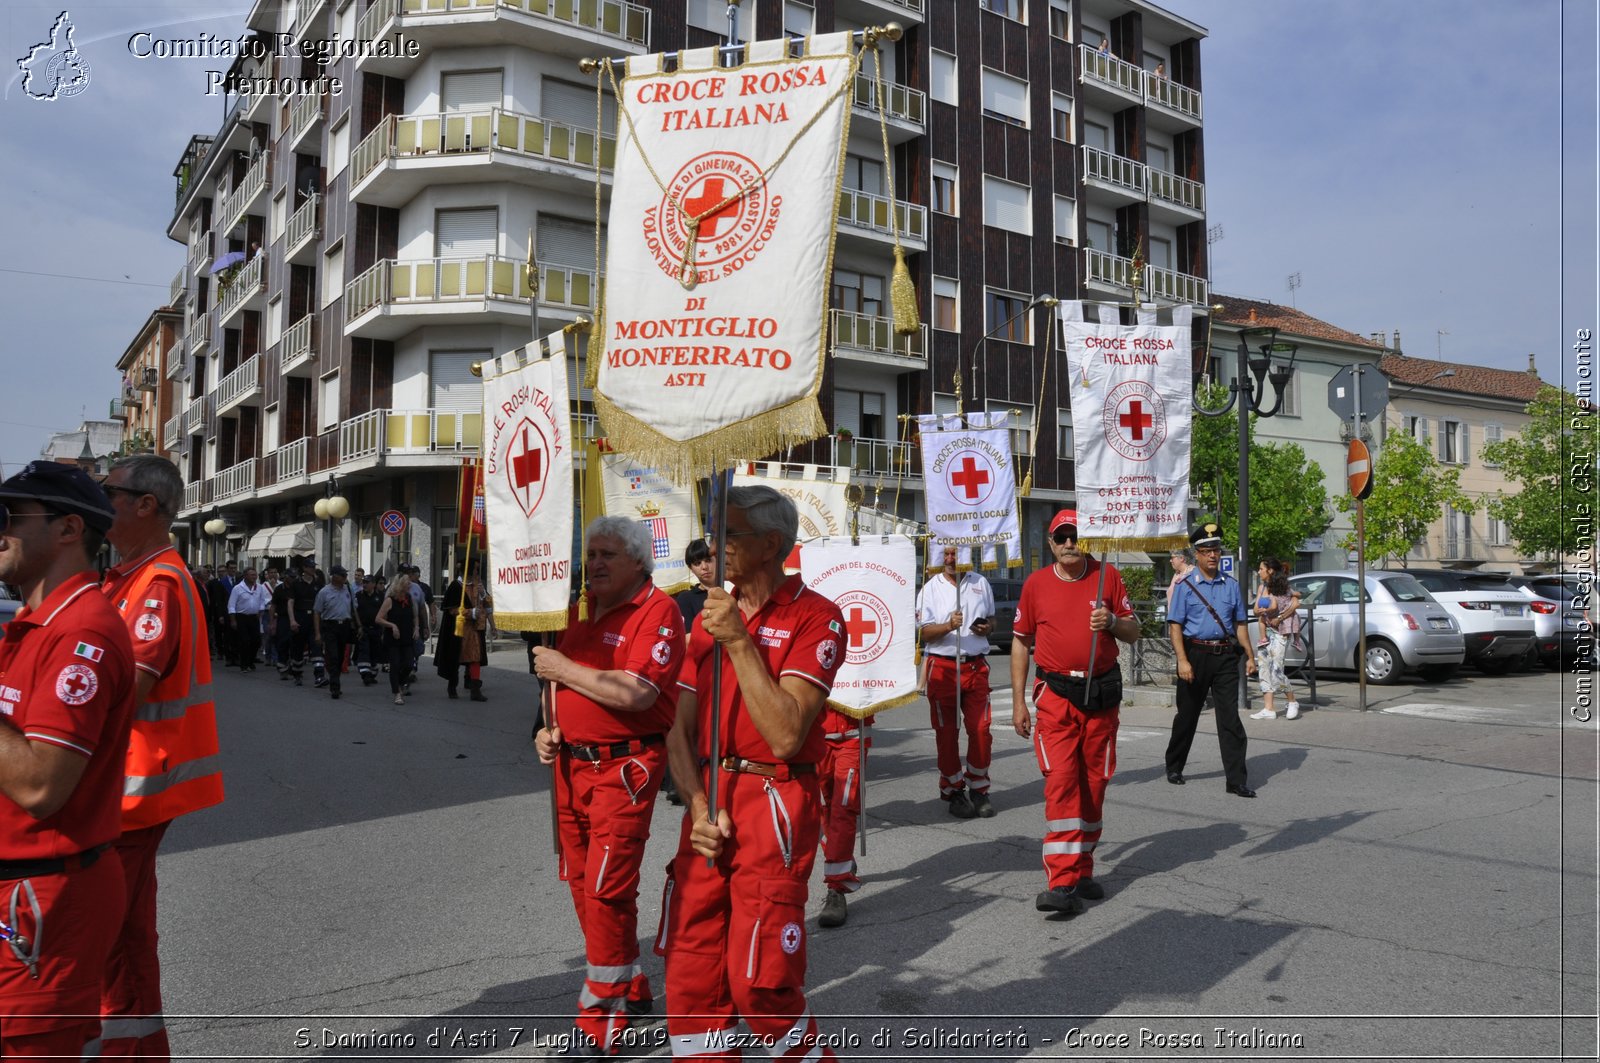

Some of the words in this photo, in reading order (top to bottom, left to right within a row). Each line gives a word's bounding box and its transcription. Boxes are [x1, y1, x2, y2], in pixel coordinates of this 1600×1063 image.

[636, 76, 726, 104] CROCE
[738, 64, 828, 97] ROSSA
[660, 101, 790, 132] ITALIANA
[694, 158, 742, 175] GINEVRA
[681, 171, 694, 183] DI
[714, 232, 744, 255] 1864
[722, 194, 784, 278] SOCCORSO
[684, 297, 706, 311] DI
[614, 316, 779, 341] MONTIGLIO
[1085, 335, 1127, 351] CROCE
[1133, 337, 1175, 350] ROSSA
[607, 346, 793, 371] MONFERRATO
[1103, 352, 1159, 366] ITALIANA
[664, 372, 707, 387] ASTI
[932, 445, 953, 474] CROCE
[952, 437, 976, 451] ROSSA
[977, 439, 1007, 470] ITALIANA
[1106, 501, 1131, 511] DON
[935, 511, 978, 523] COMITATO
[980, 508, 1010, 519] LOCALE
[1089, 516, 1095, 525] E
[972, 523, 980, 532] DI
[936, 533, 987, 546] COCCONATO
[987, 531, 1013, 541] D'ASTI
[543, 543, 552, 556] DI
[1222, 560, 1231, 571] P
[809, 562, 849, 589] VOLONTARI
[848, 561, 864, 569] DEL
[865, 561, 907, 586] SOCCORSO
[860, 594, 869, 602] DI
[869, 598, 890, 628] GINEVRA
[852, 679, 860, 688] di
[862, 679, 897, 688] MONTA'
